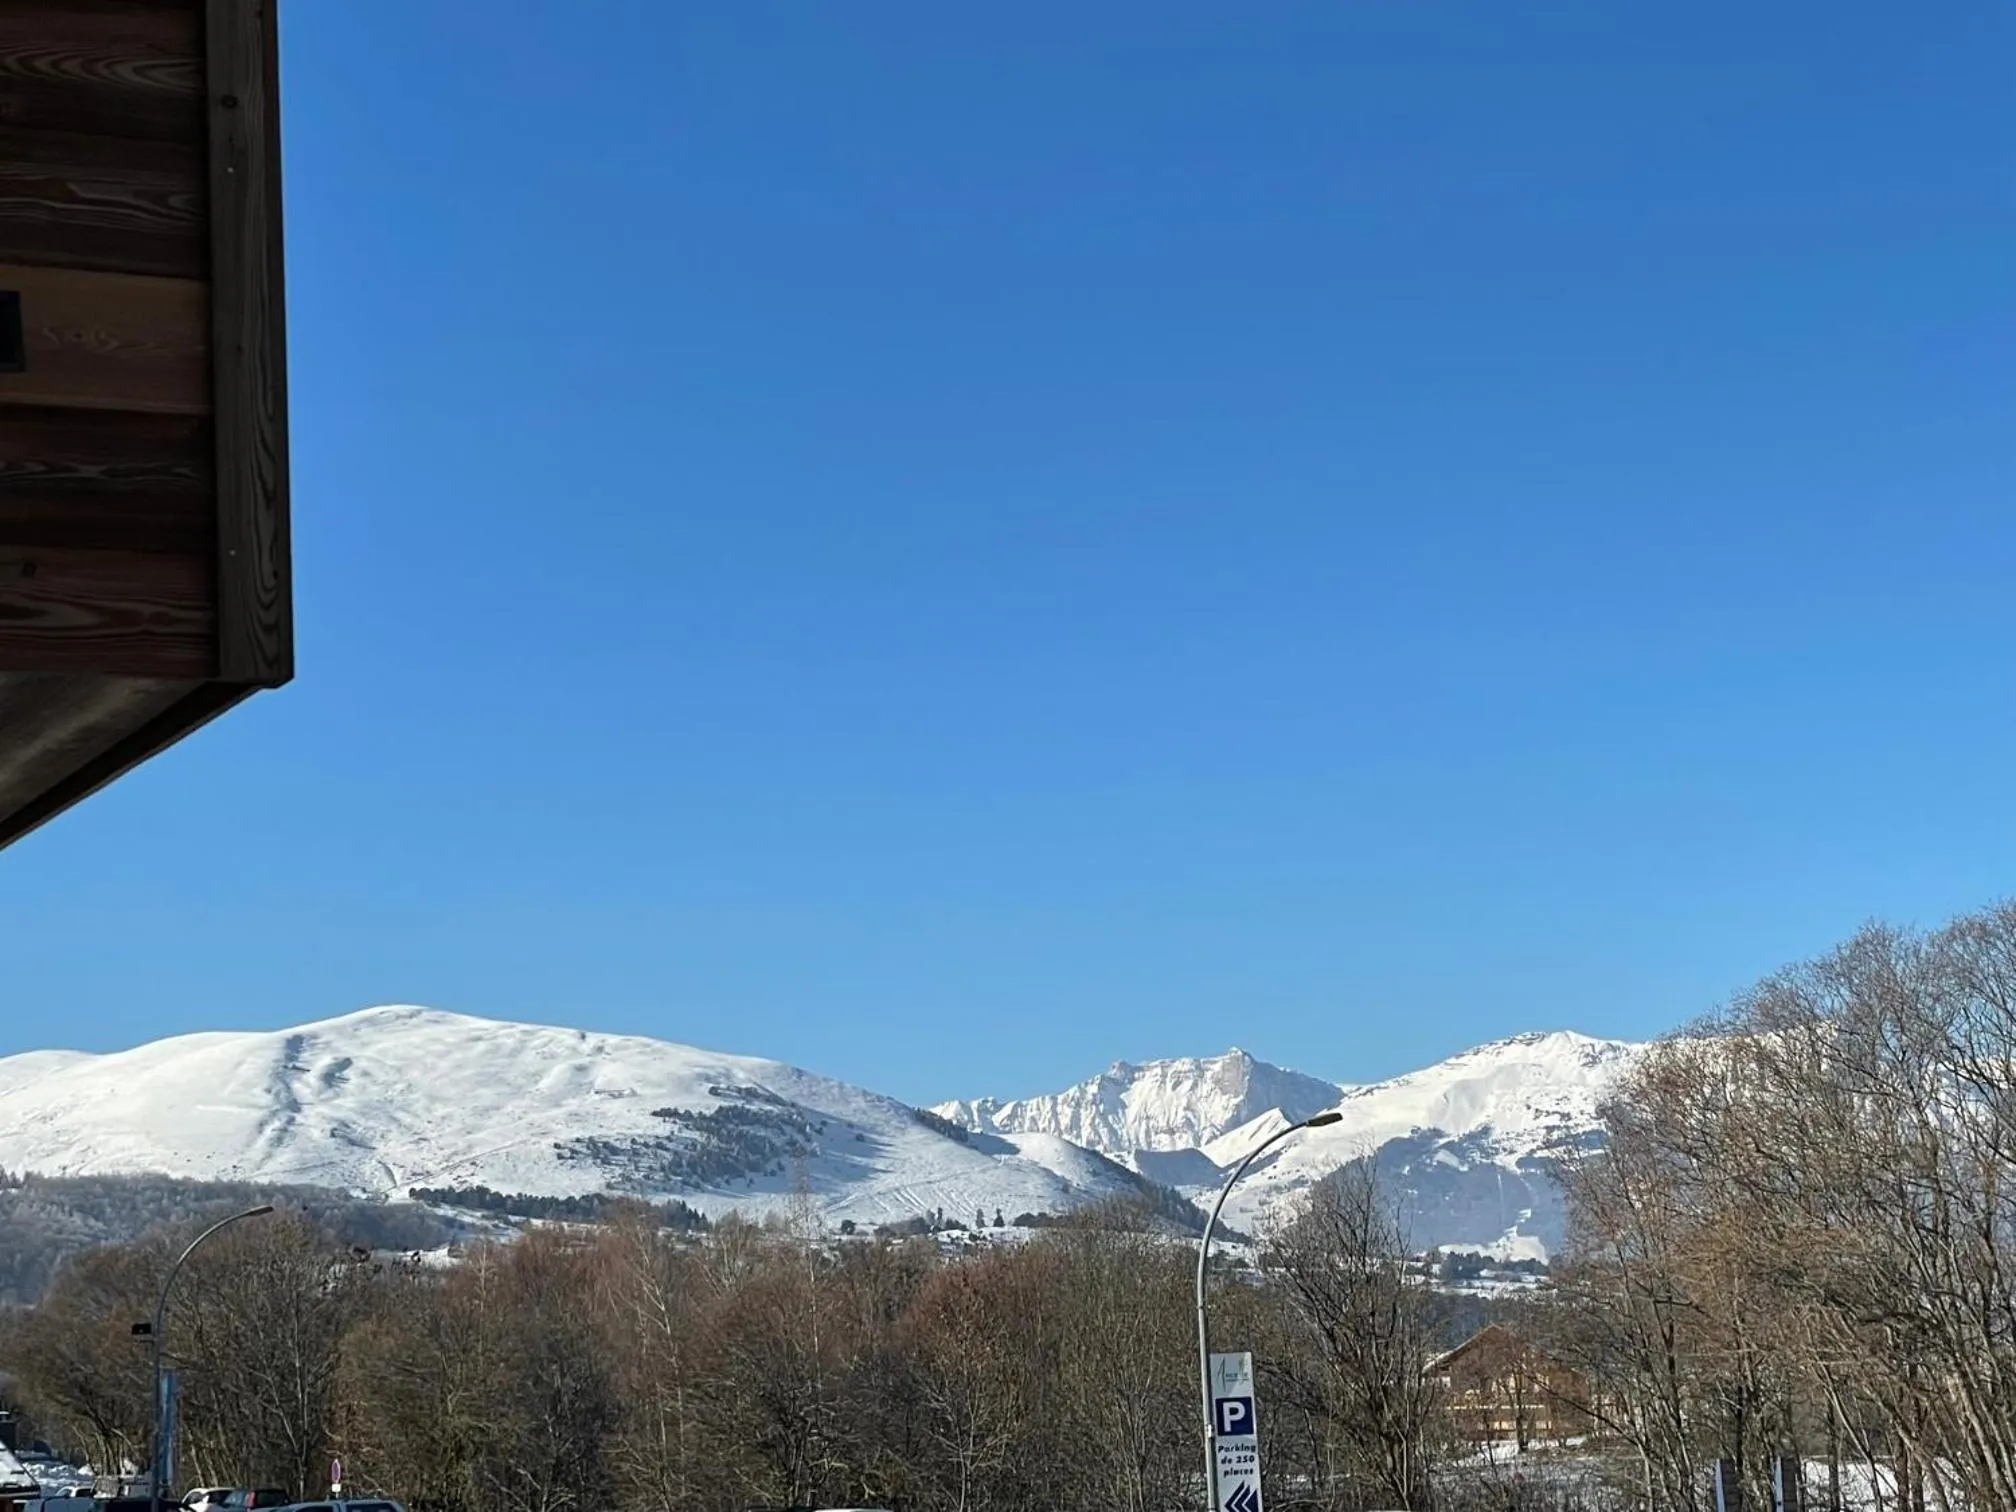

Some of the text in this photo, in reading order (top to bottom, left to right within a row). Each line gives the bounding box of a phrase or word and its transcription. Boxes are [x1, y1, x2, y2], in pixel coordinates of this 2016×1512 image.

[1222, 1401, 1246, 1432] P
[1218, 1443, 1256, 1453] Parking
[1221, 1455, 1255, 1464] de 250
[1223, 1467, 1254, 1478] places
